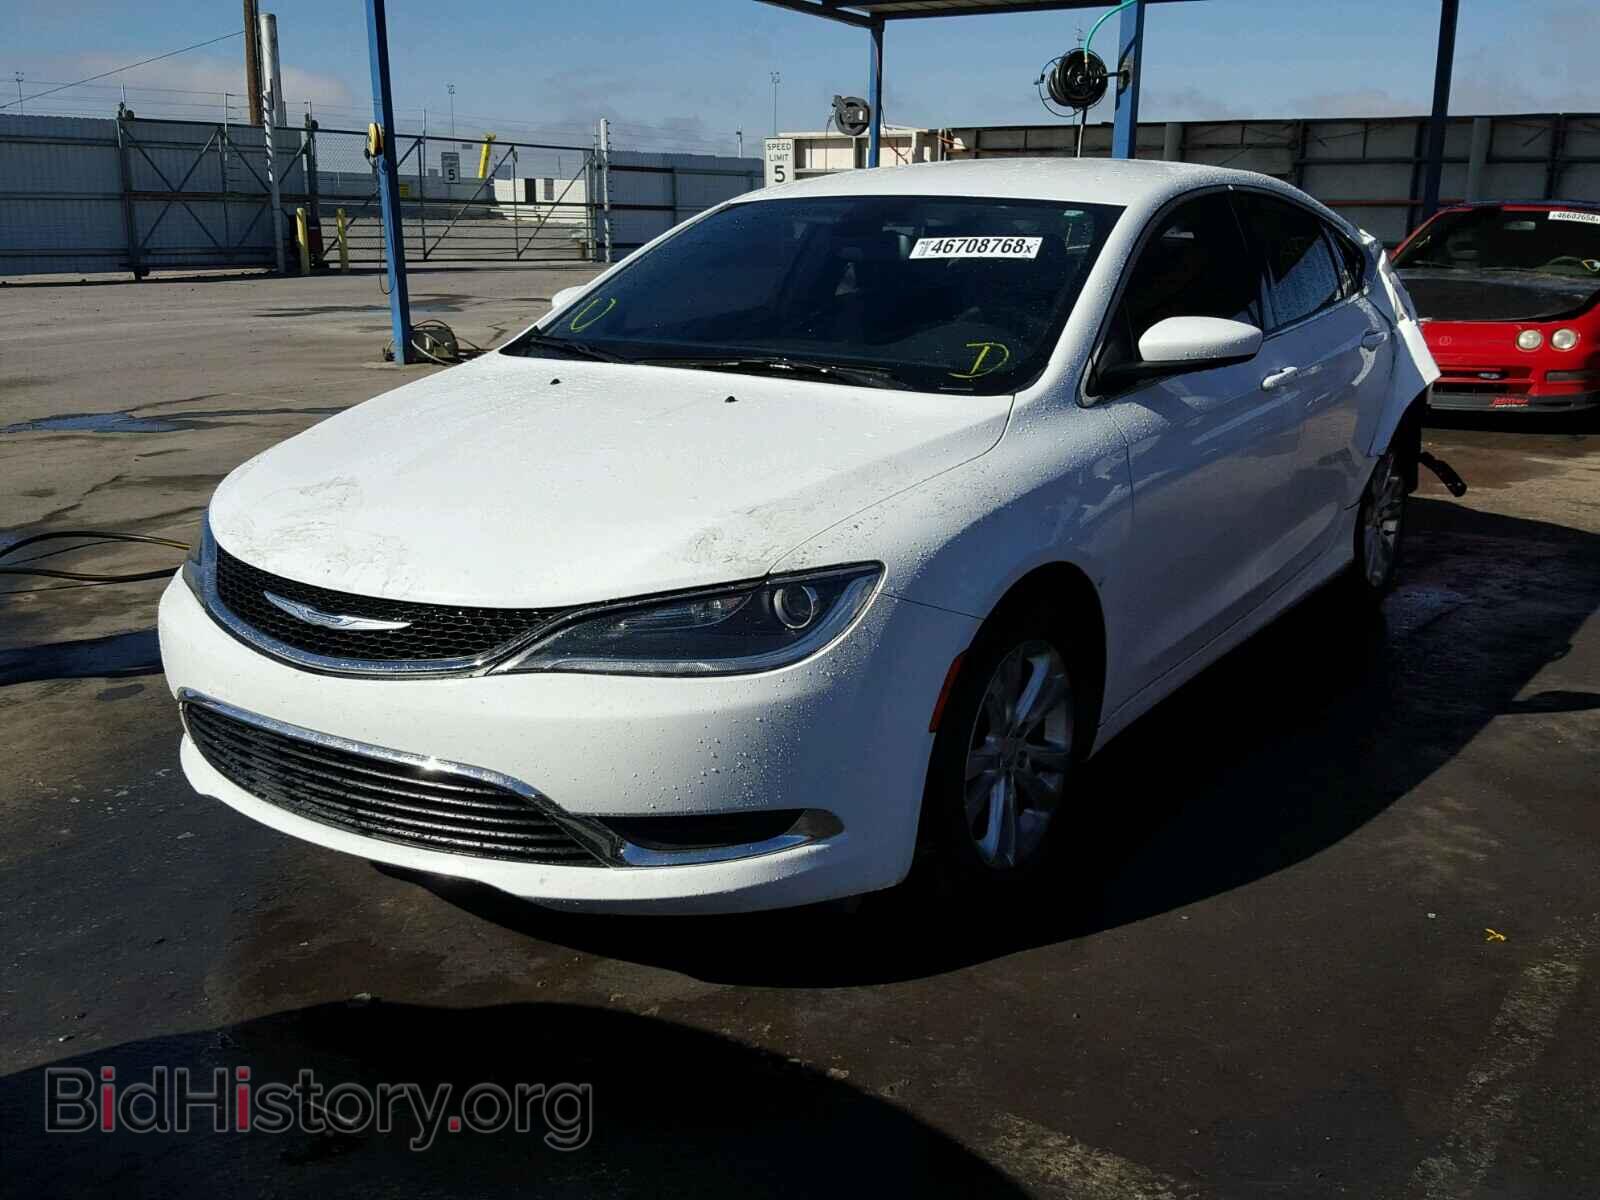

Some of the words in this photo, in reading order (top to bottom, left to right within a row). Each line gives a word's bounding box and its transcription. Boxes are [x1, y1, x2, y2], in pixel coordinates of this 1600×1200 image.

[767, 143, 791, 151] SPEED
[769, 153, 789, 161] LIMIT
[448, 168, 456, 181] 5
[774, 165, 785, 183] 5
[947, 341, 1009, 379] D
